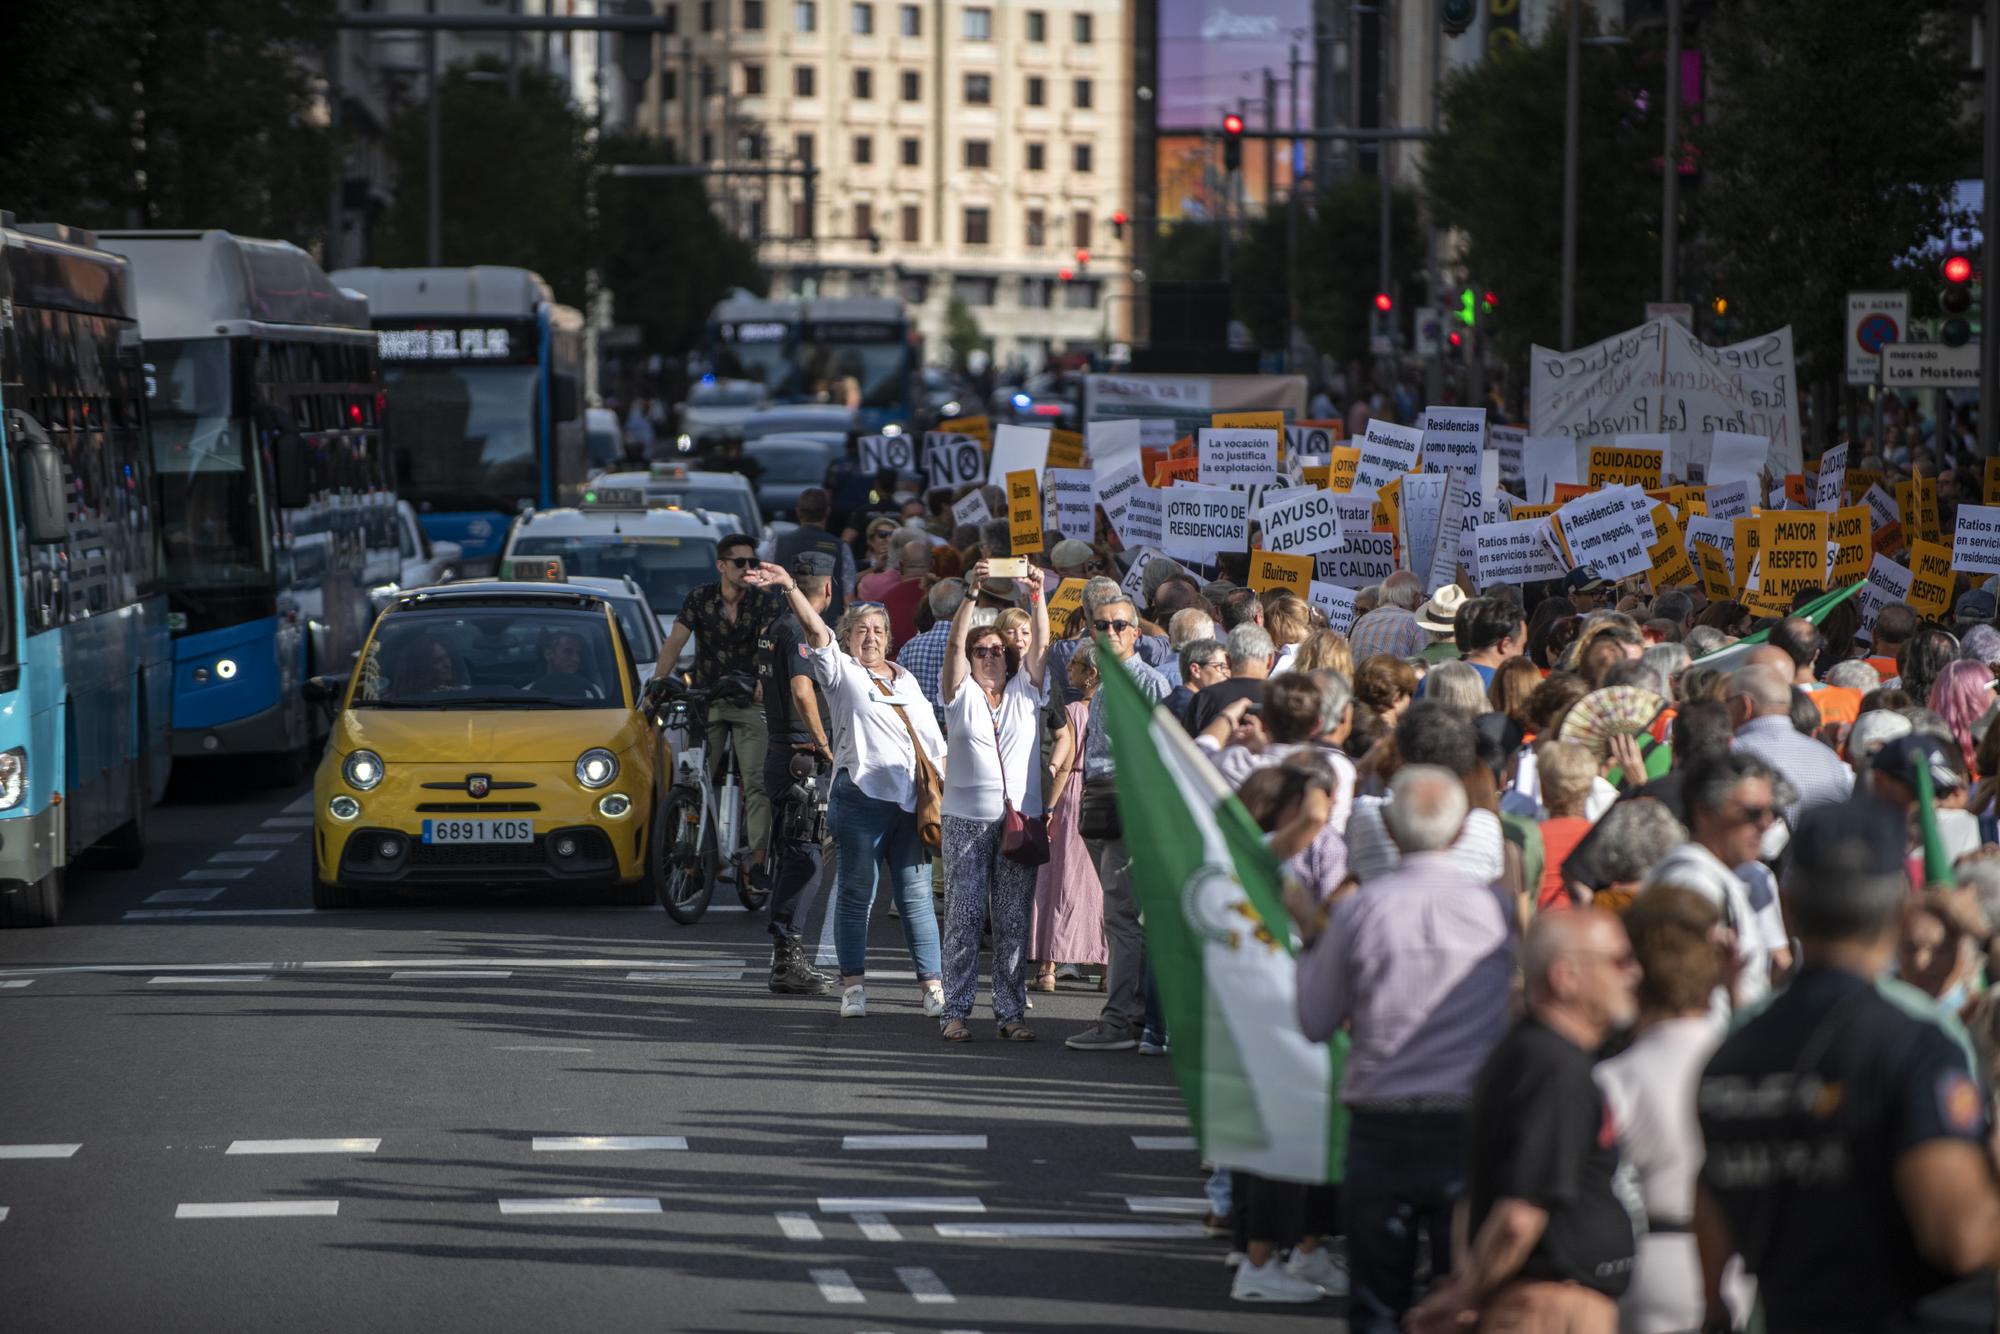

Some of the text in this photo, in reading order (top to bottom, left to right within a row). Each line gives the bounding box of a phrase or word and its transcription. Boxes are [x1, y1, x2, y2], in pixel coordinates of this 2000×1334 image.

[1889, 351, 1939, 360] mercado
[1890, 368, 1913, 378] Los
[1427, 418, 1479, 432] Residencias
[1209, 438, 1269, 448] La vocación
[1367, 431, 1415, 452] Residencias
[1426, 442, 1478, 457] como negocio,
[932, 443, 980, 486] NO
[1211, 451, 1266, 462] no justifica
[1362, 453, 1381, 465] como
[1593, 451, 1662, 470] CUIDADOS
[1203, 463, 1275, 474] la explotación.
[1099, 474, 1140, 502] Residencias
[1356, 472, 1372, 487] ¡No,
[1374, 478, 1385, 488] no
[1591, 473, 1606, 488] DE
[1711, 492, 1745, 509] La vocación
[1167, 502, 1246, 520] ¡OTRO TIPO DE
[1265, 497, 1333, 535] ¡AYUSO,
[1571, 500, 1625, 528] Residencias
[1170, 521, 1244, 539] RESIDENCIAS!
[1958, 518, 1991, 532] Ratios
[1271, 519, 1337, 552] ABUSO!
[1478, 533, 1530, 549] Ratios más
[1581, 536, 1601, 550] como
[1601, 522, 1634, 543] negocio,
[1774, 523, 1816, 545] ¡MAYOR
[1956, 537, 1967, 546] en
[1321, 539, 1393, 556] IDADOS
[1607, 553, 1619, 566] no
[1619, 551, 1627, 564] y
[1626, 542, 1643, 558] no!
[1479, 555, 1489, 564] en
[1490, 550, 1527, 562] servicios
[1769, 551, 1817, 568] RESPETO
[1954, 552, 1960, 564] y
[1320, 561, 1392, 579] DE CALIDAD
[1480, 570, 1485, 581] y
[1485, 566, 1523, 578] residencias
[1524, 564, 1533, 574] de
[1919, 554, 1951, 578] ¡MAYOR
[1763, 579, 1778, 597] AL
[1912, 579, 1946, 605] RESPETO
[1314, 592, 1328, 604] La
[436, 822, 529, 840] 6891 KDS
